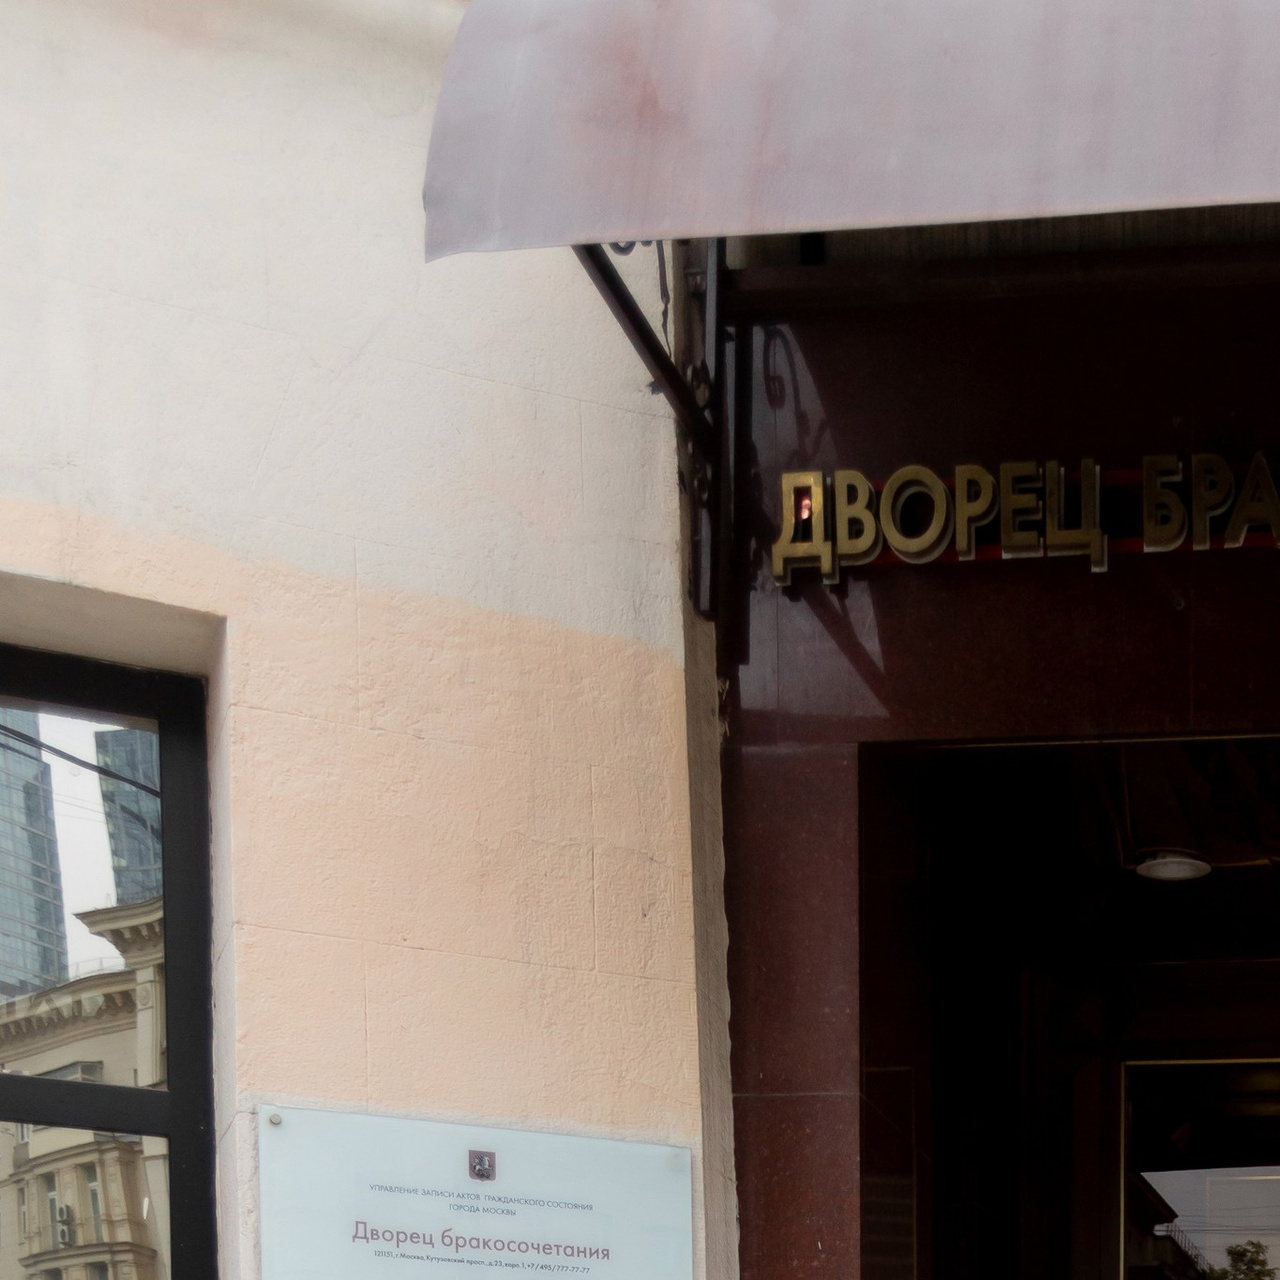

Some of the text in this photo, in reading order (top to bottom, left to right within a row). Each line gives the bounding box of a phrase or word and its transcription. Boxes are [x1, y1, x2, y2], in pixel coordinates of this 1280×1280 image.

[772, 459, 1107, 586] ДВОРЕЦ
[369, 1184, 593, 1211] УПРАВЛЕНИЕ ЗАПИСИ АКТОВ ГРАЖДАНСКОГО СОСТОЯНИЯ
[449, 1203, 516, 1216] ГОРОДА МОСКВЫ
[352, 1220, 610, 1260] Дворец бракосочетания
